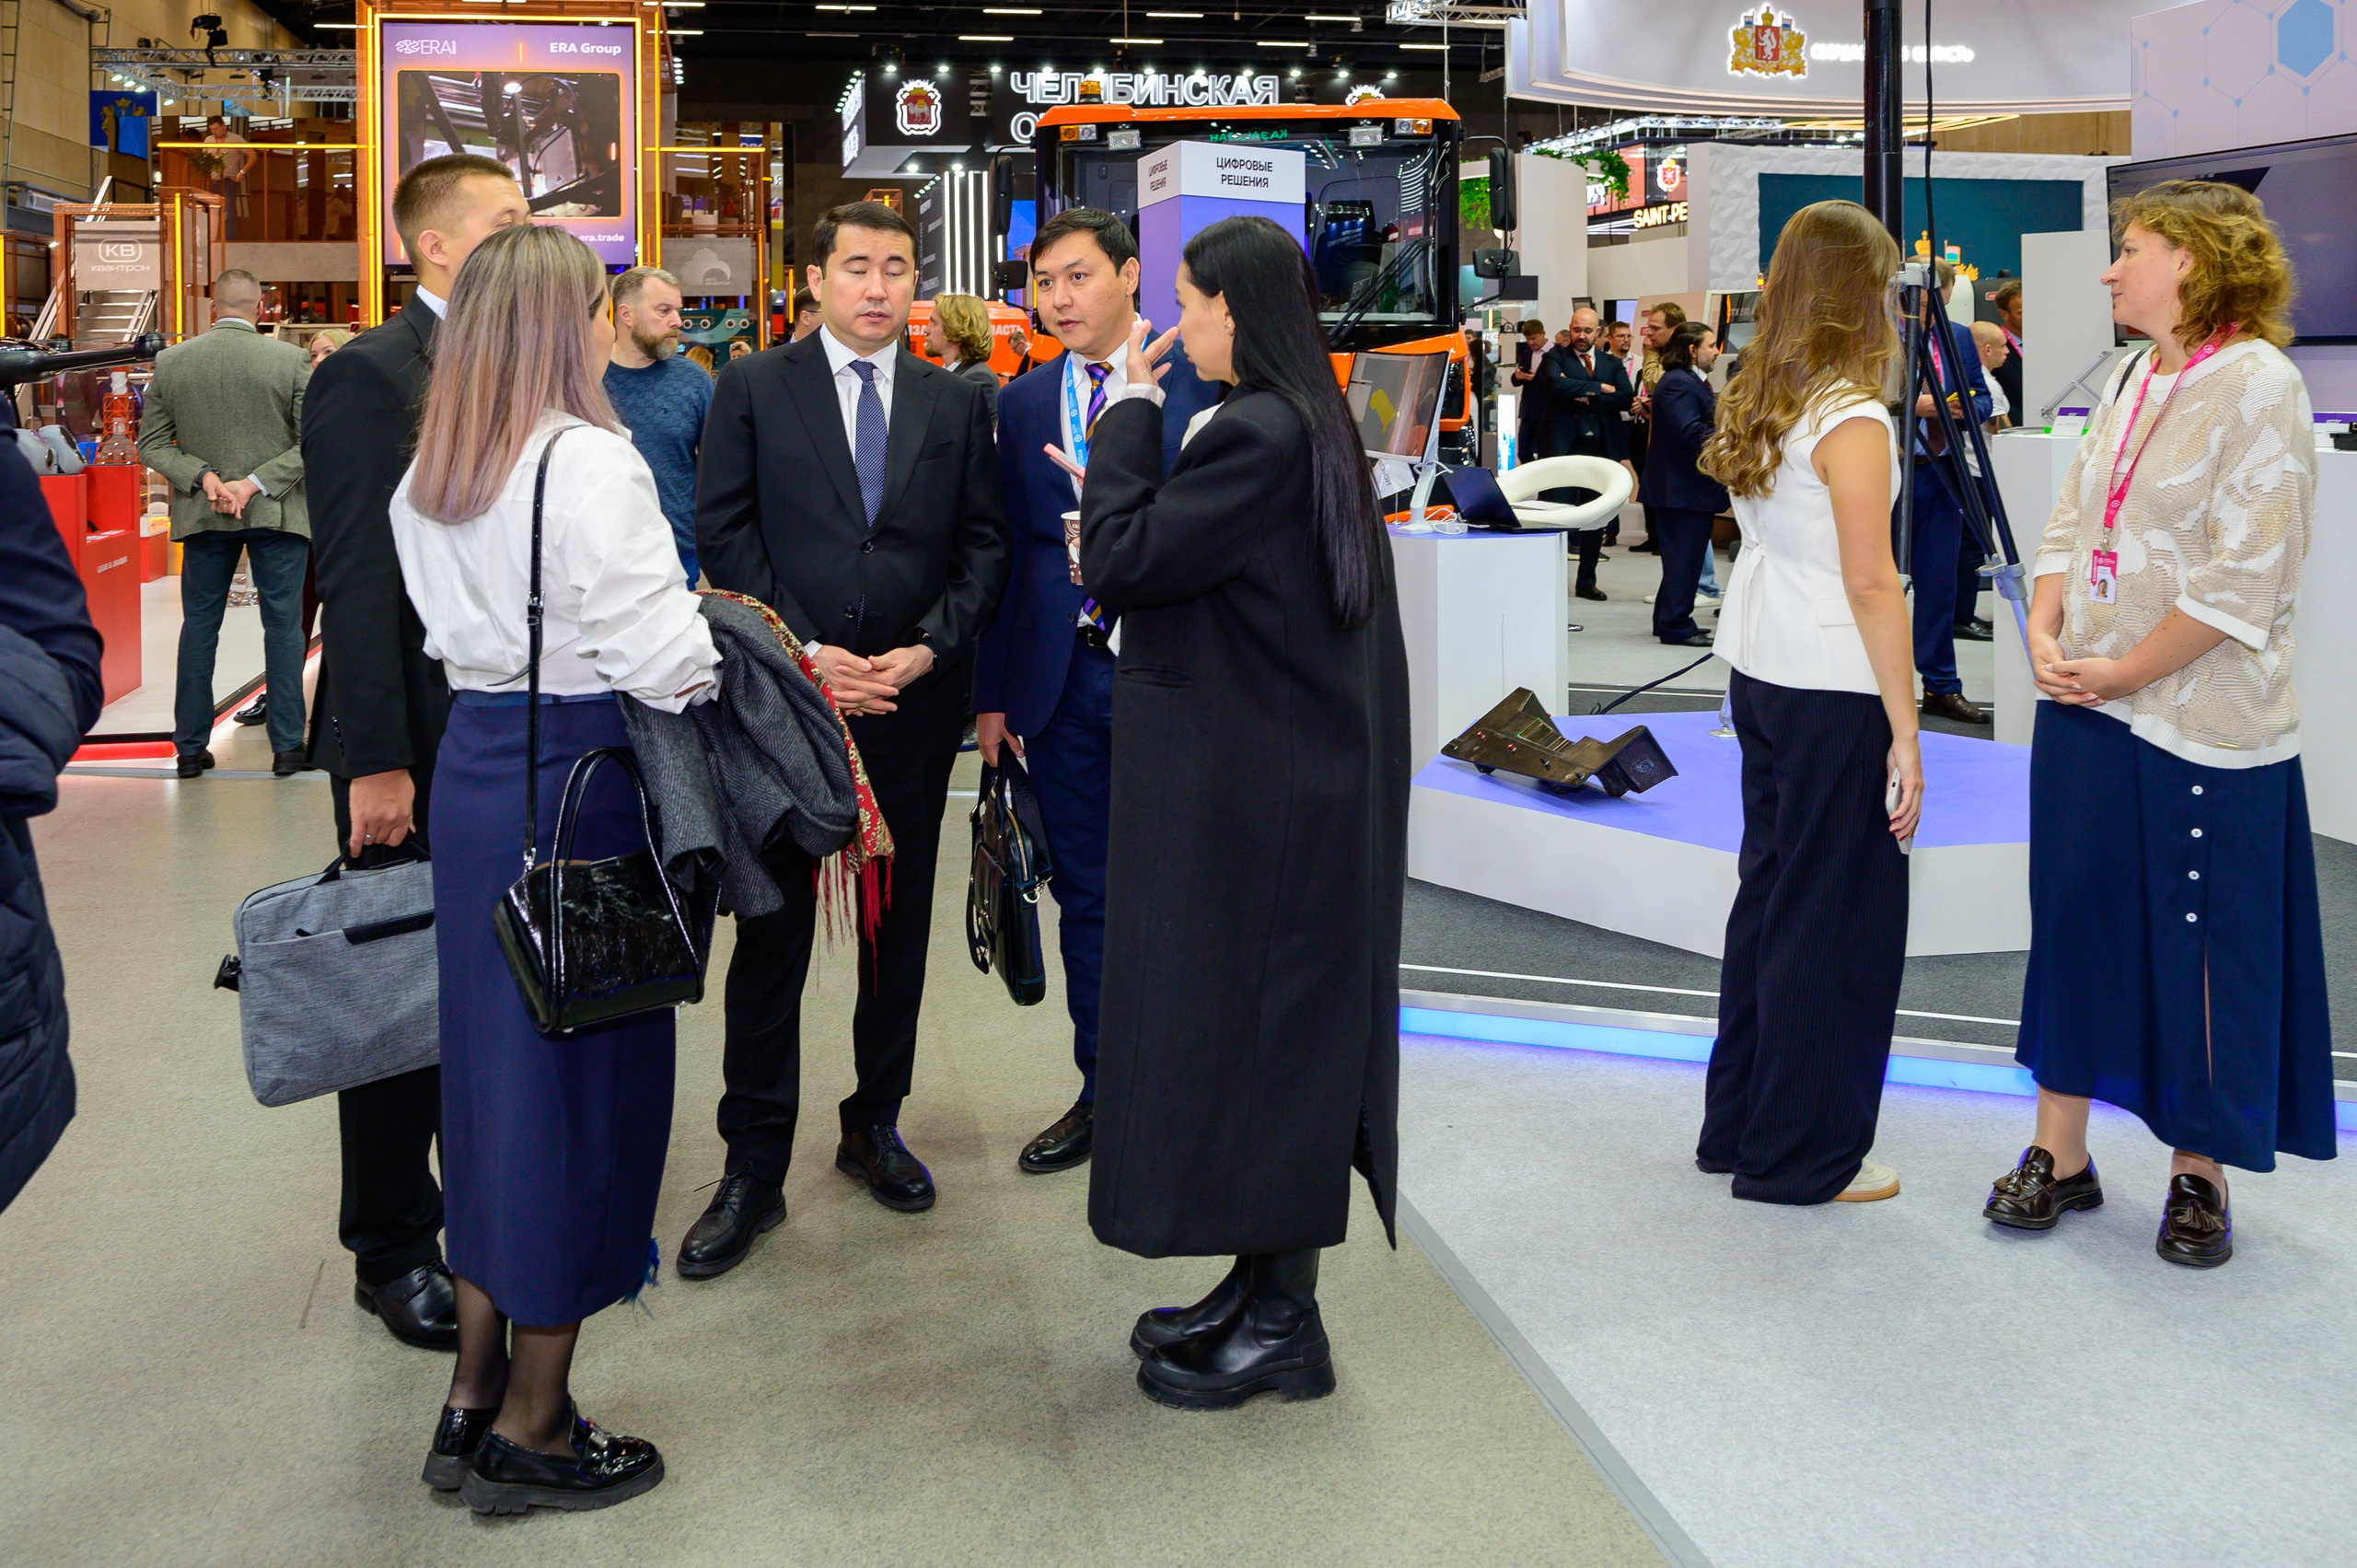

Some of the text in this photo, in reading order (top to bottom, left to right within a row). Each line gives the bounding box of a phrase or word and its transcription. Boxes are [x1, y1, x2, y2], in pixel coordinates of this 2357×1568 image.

[421, 41, 452, 54] ERA
[550, 41, 621, 56] ERA Group
[1010, 71, 1280, 105] ЧЕЛБИНСКАЯ
[1215, 157, 1273, 172] ЦИФРОВЫЕ
[1221, 174, 1269, 189] РЕШЕНИЯ
[578, 233, 625, 242] era.trade
